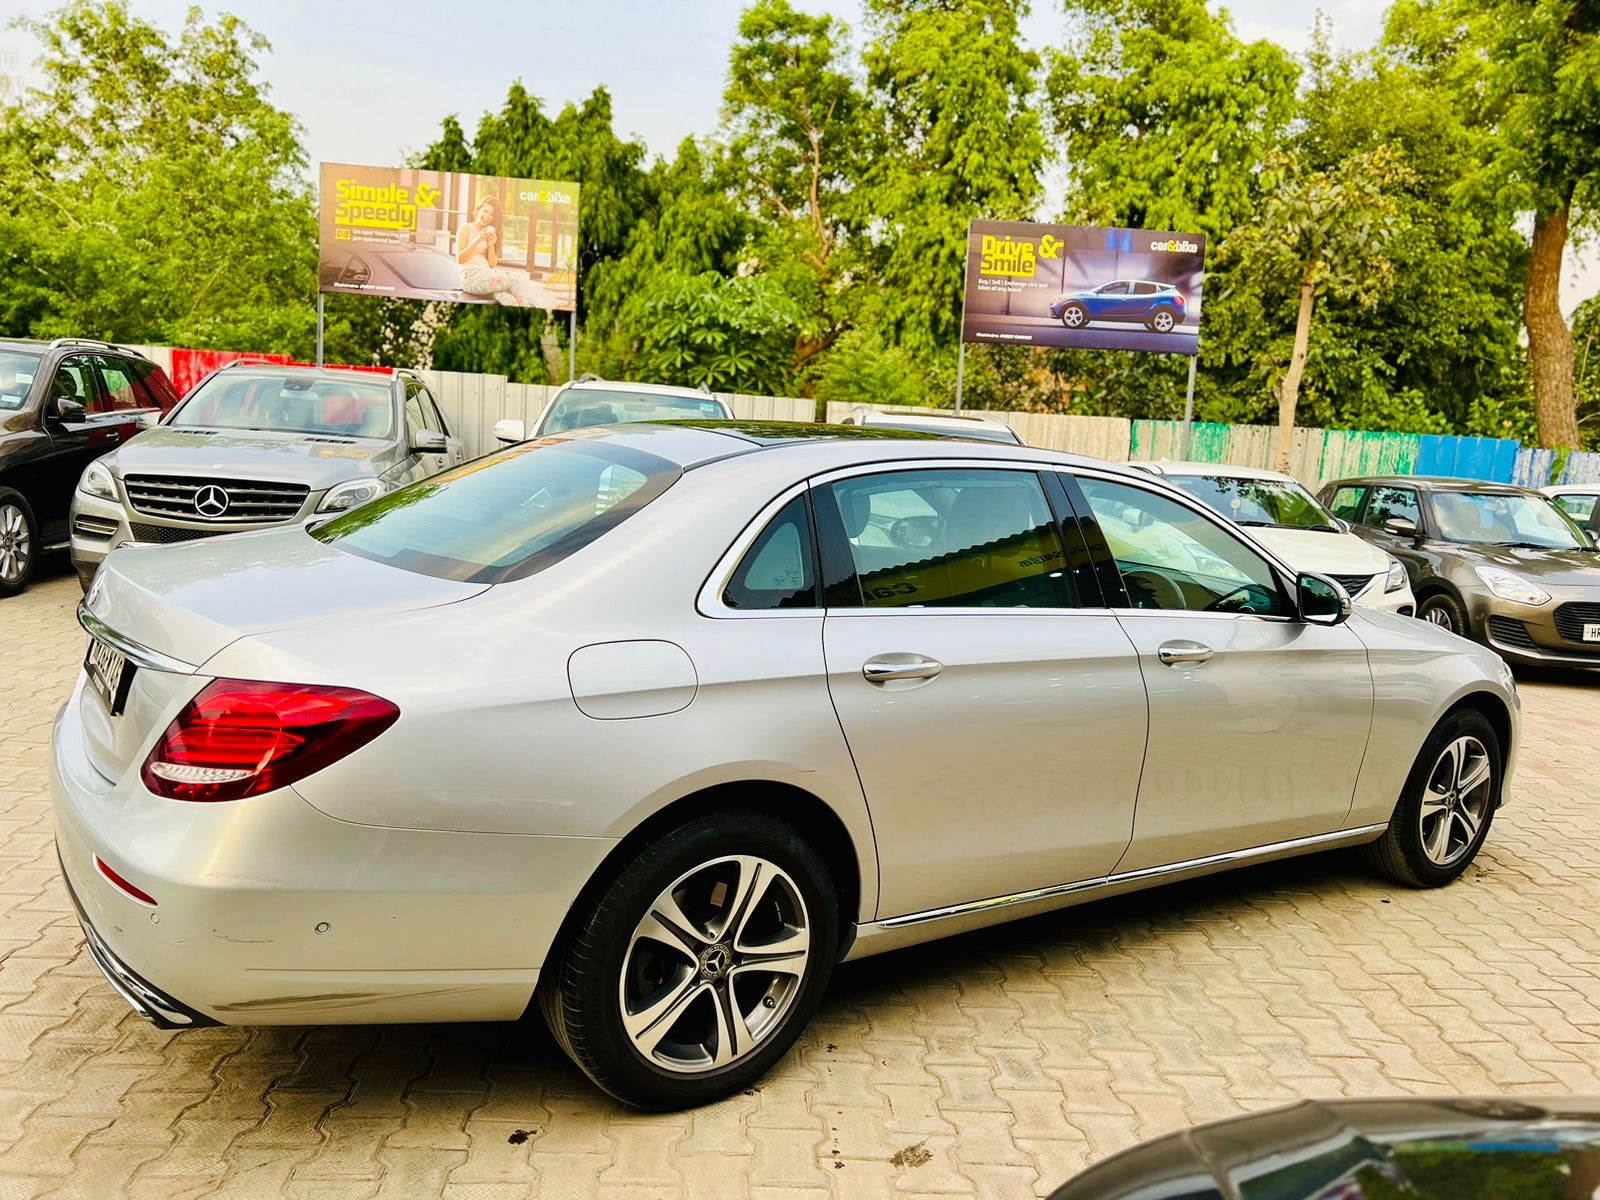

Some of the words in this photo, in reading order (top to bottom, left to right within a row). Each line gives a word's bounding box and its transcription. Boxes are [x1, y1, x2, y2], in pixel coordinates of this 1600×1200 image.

[336, 179, 409, 204] Simple
[414, 183, 442, 207] &
[520, 190, 571, 204] car&bike
[336, 201, 414, 228] Speedy
[982, 235, 1034, 256] Drive
[1038, 234, 1064, 259] &
[1151, 240, 1198, 254] car&bike
[981, 255, 1033, 273] Smile
[1004, 280, 1027, 288] Exchange
